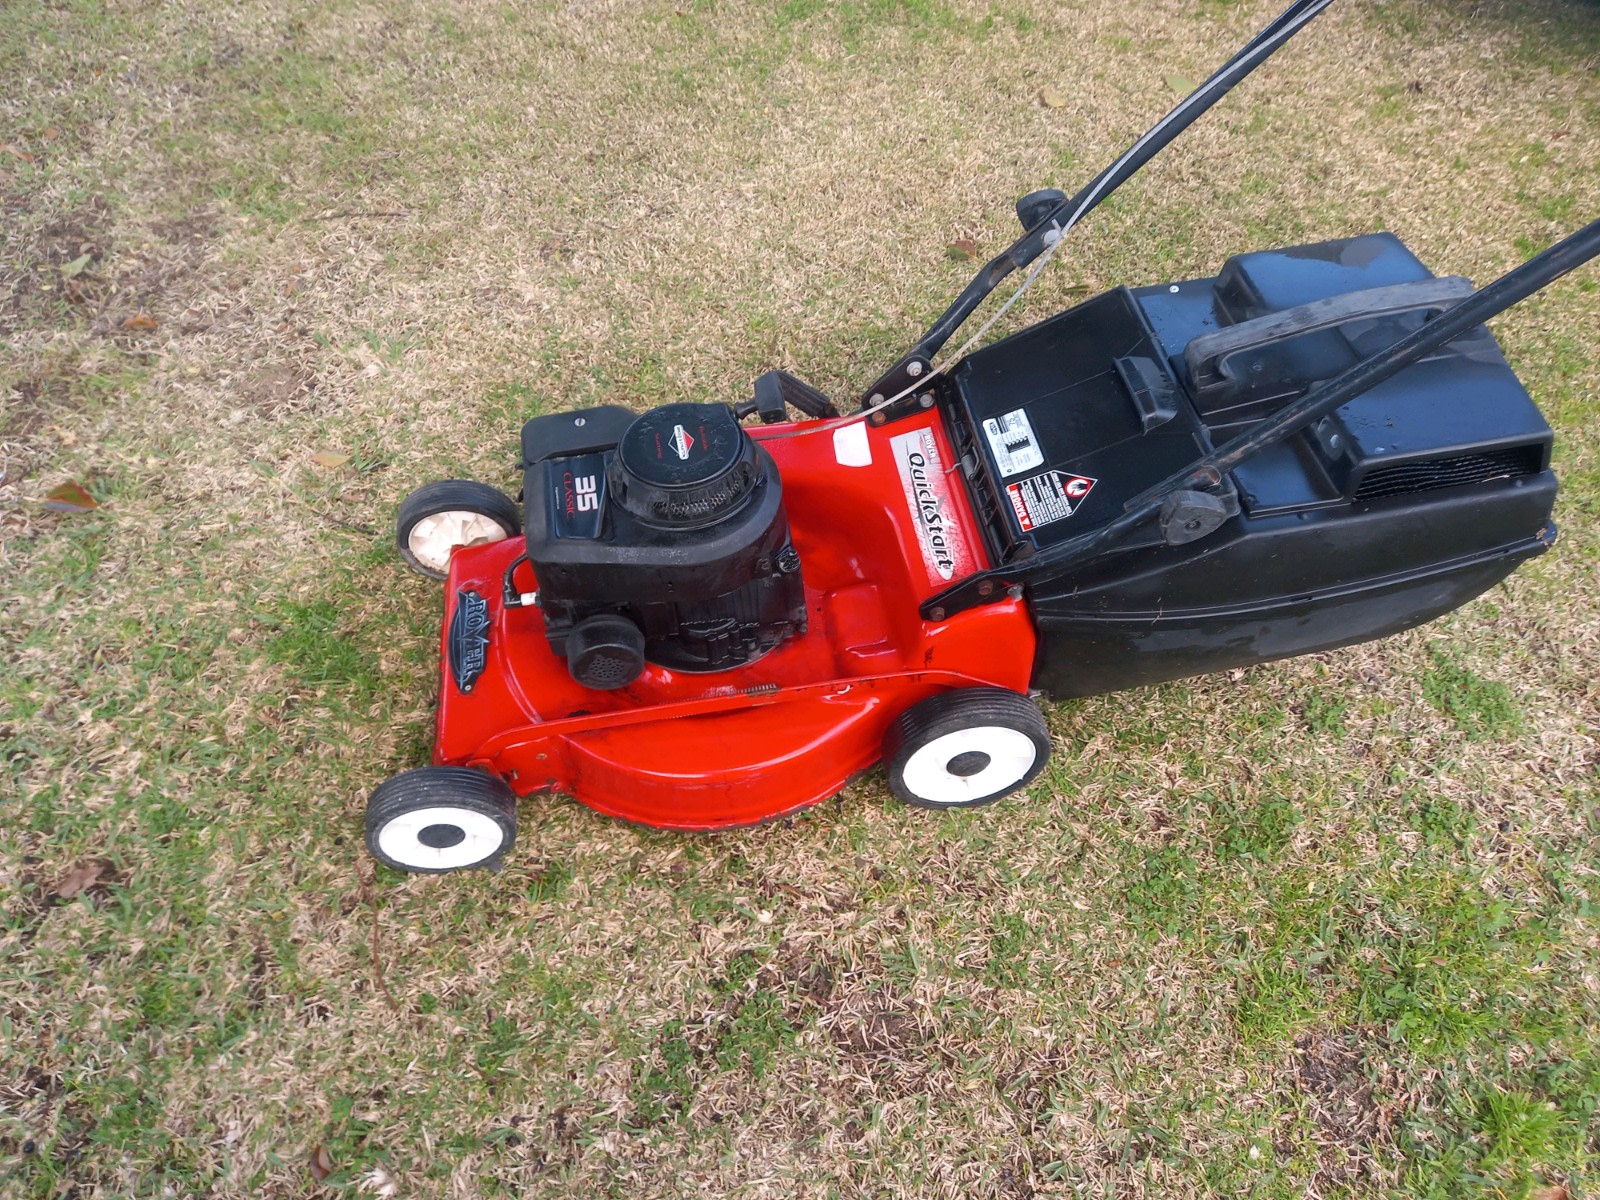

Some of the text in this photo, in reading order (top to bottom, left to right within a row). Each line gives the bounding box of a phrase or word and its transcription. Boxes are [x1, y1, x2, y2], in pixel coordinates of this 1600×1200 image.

[924, 434, 936, 459] ROVER
[563, 471, 576, 520] CLASSIC
[575, 475, 598, 511] 35
[909, 452, 953, 570] QuickStart
[1009, 488, 1026, 517] DANGER
[464, 600, 490, 676] ROVER
